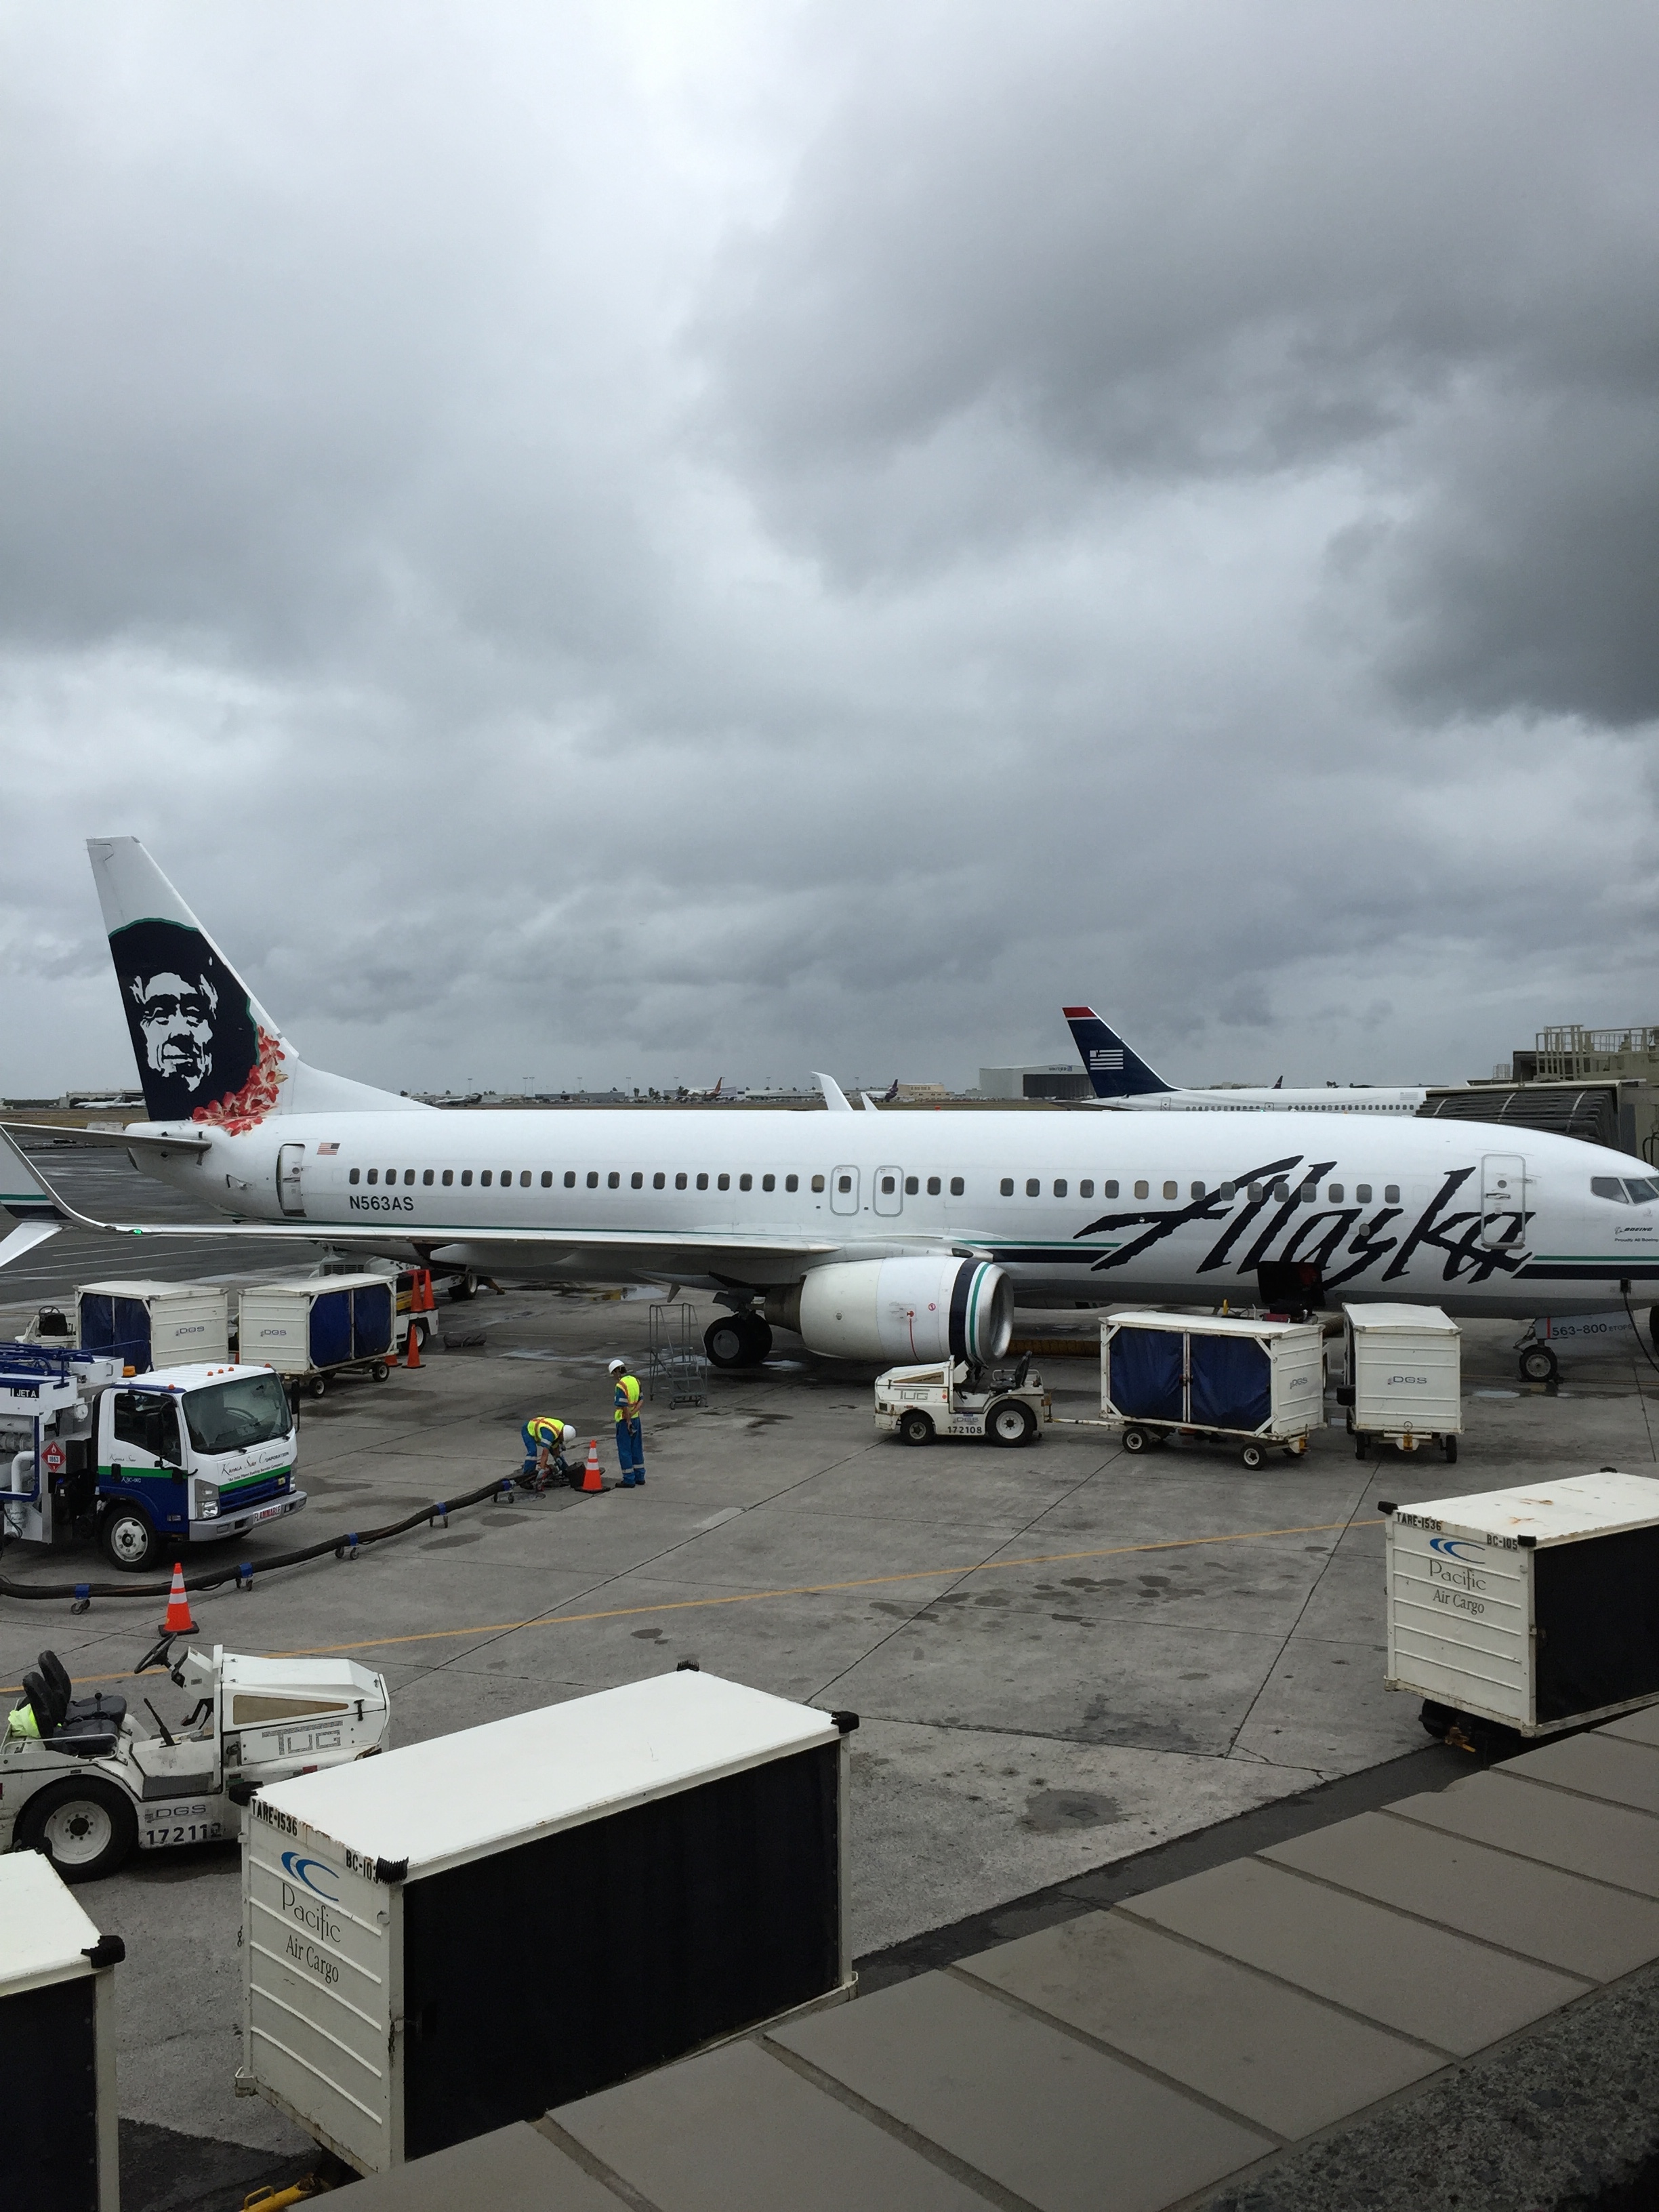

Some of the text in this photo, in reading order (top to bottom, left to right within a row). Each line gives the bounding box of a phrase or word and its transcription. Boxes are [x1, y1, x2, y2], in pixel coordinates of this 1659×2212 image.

[350, 1195, 414, 1211] N563AS
[1073, 1155, 1536, 1290] Alaska
[180, 1326, 205, 1334] DGS
[1552, 1324, 1607, 1336] 563-800
[1292, 1377, 1308, 1387] DGS
[1393, 1376, 1427, 1384] DGS
[16, 1389, 37, 1398] JET A
[894, 1388, 930, 1400] TUG
[947, 1426, 982, 1434] 172108
[1397, 1512, 1442, 1531] TARE-1536
[1487, 1534, 1518, 1551] BC-105
[1429, 1559, 1486, 1591] Pacific
[1433, 1589, 1485, 1615] Air Cargo
[262, 1720, 343, 1755] TUG
[156, 1804, 207, 1818] DGS
[251, 1799, 298, 1837] TARE-1536
[282, 1882, 341, 1943] Pacific
[285, 1934, 339, 1984] Air Cargo
